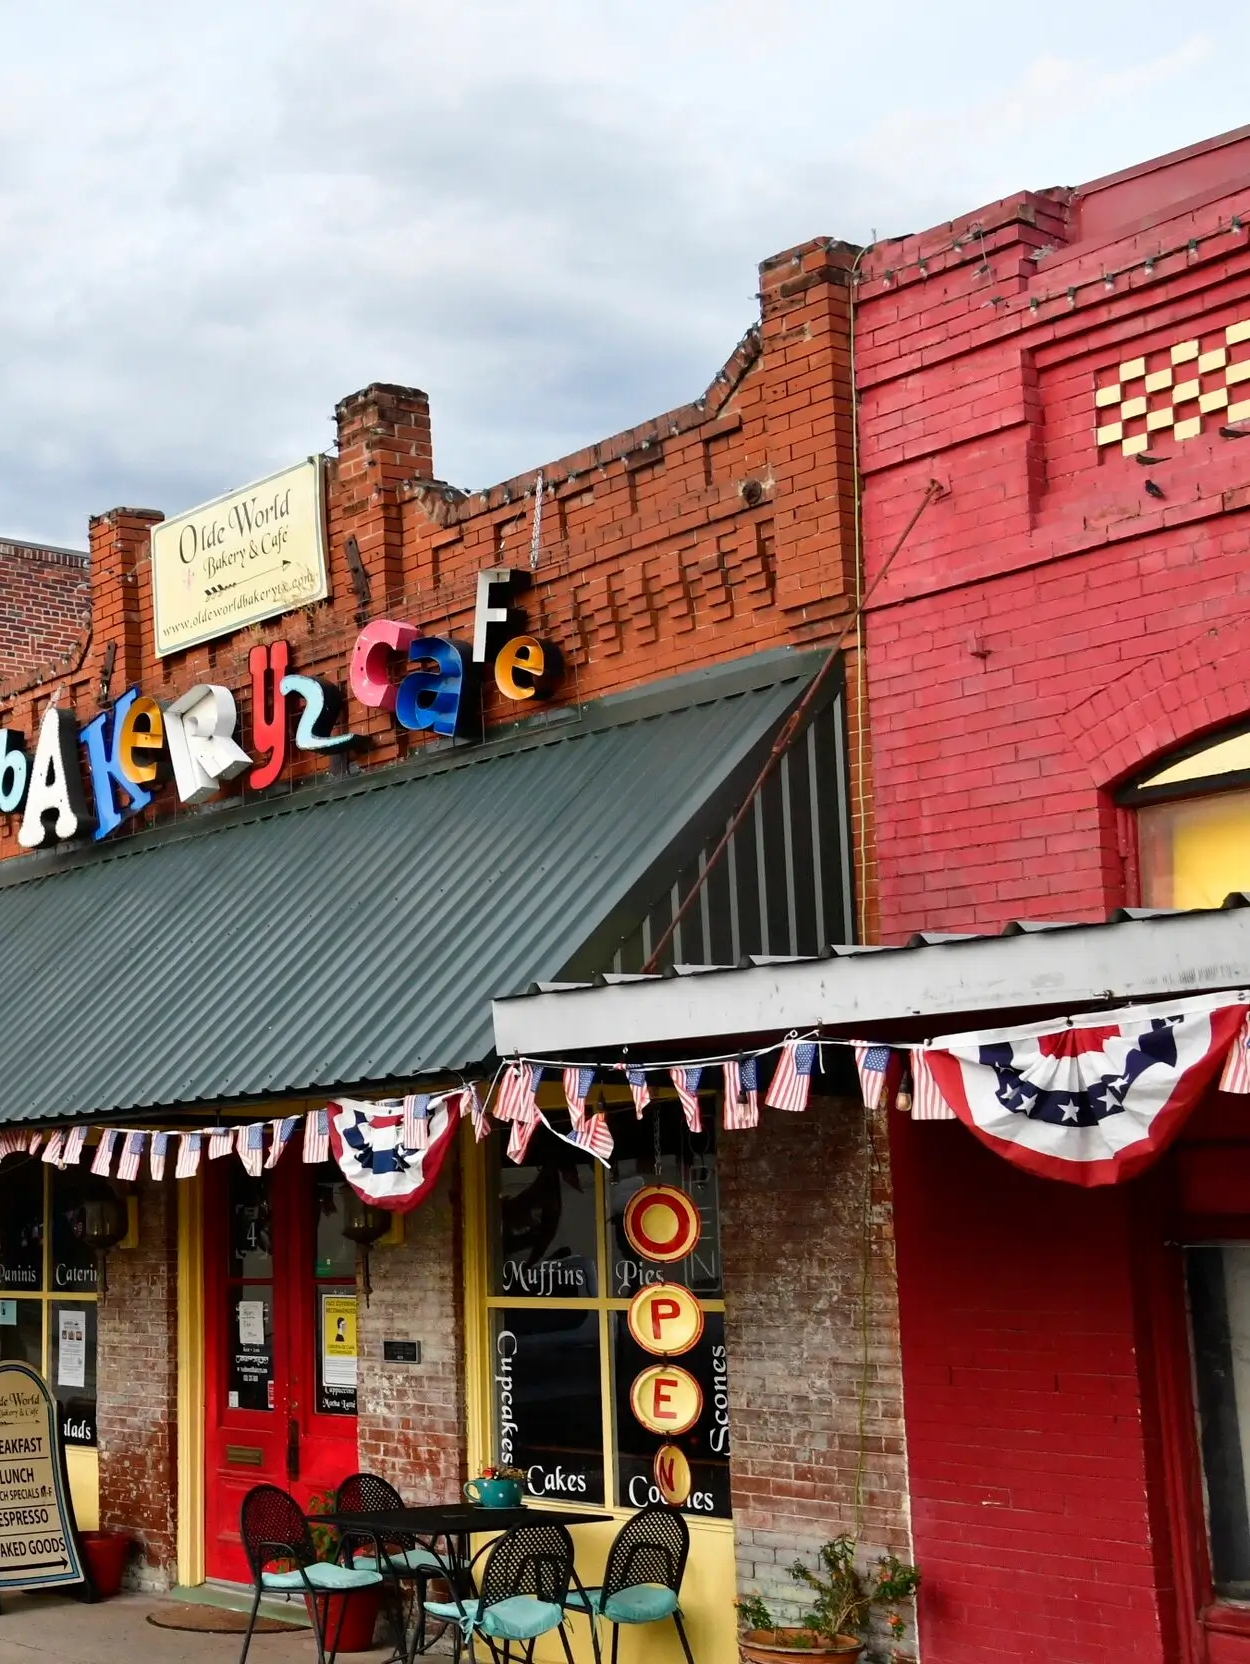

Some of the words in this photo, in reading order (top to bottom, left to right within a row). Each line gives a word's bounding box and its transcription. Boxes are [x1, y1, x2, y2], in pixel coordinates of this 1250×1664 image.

[179, 521, 225, 564] Olde
[228, 488, 291, 537] World
[203, 546, 245, 579] Bakery
[250, 539, 259, 560] &
[503, 1260, 584, 1295] Muffins
[615, 1260, 664, 1295] Pies
[9, 1392, 40, 1406] World
[495, 1330, 518, 1464] Cupcakes
[710, 1344, 731, 1456] Scones
[0, 1468, 35, 1484] LUNCH
[527, 1465, 587, 1496] Cakes
[10, 1488, 40, 1501] SPECIALS
[29, 1537, 66, 1555] GOODS
